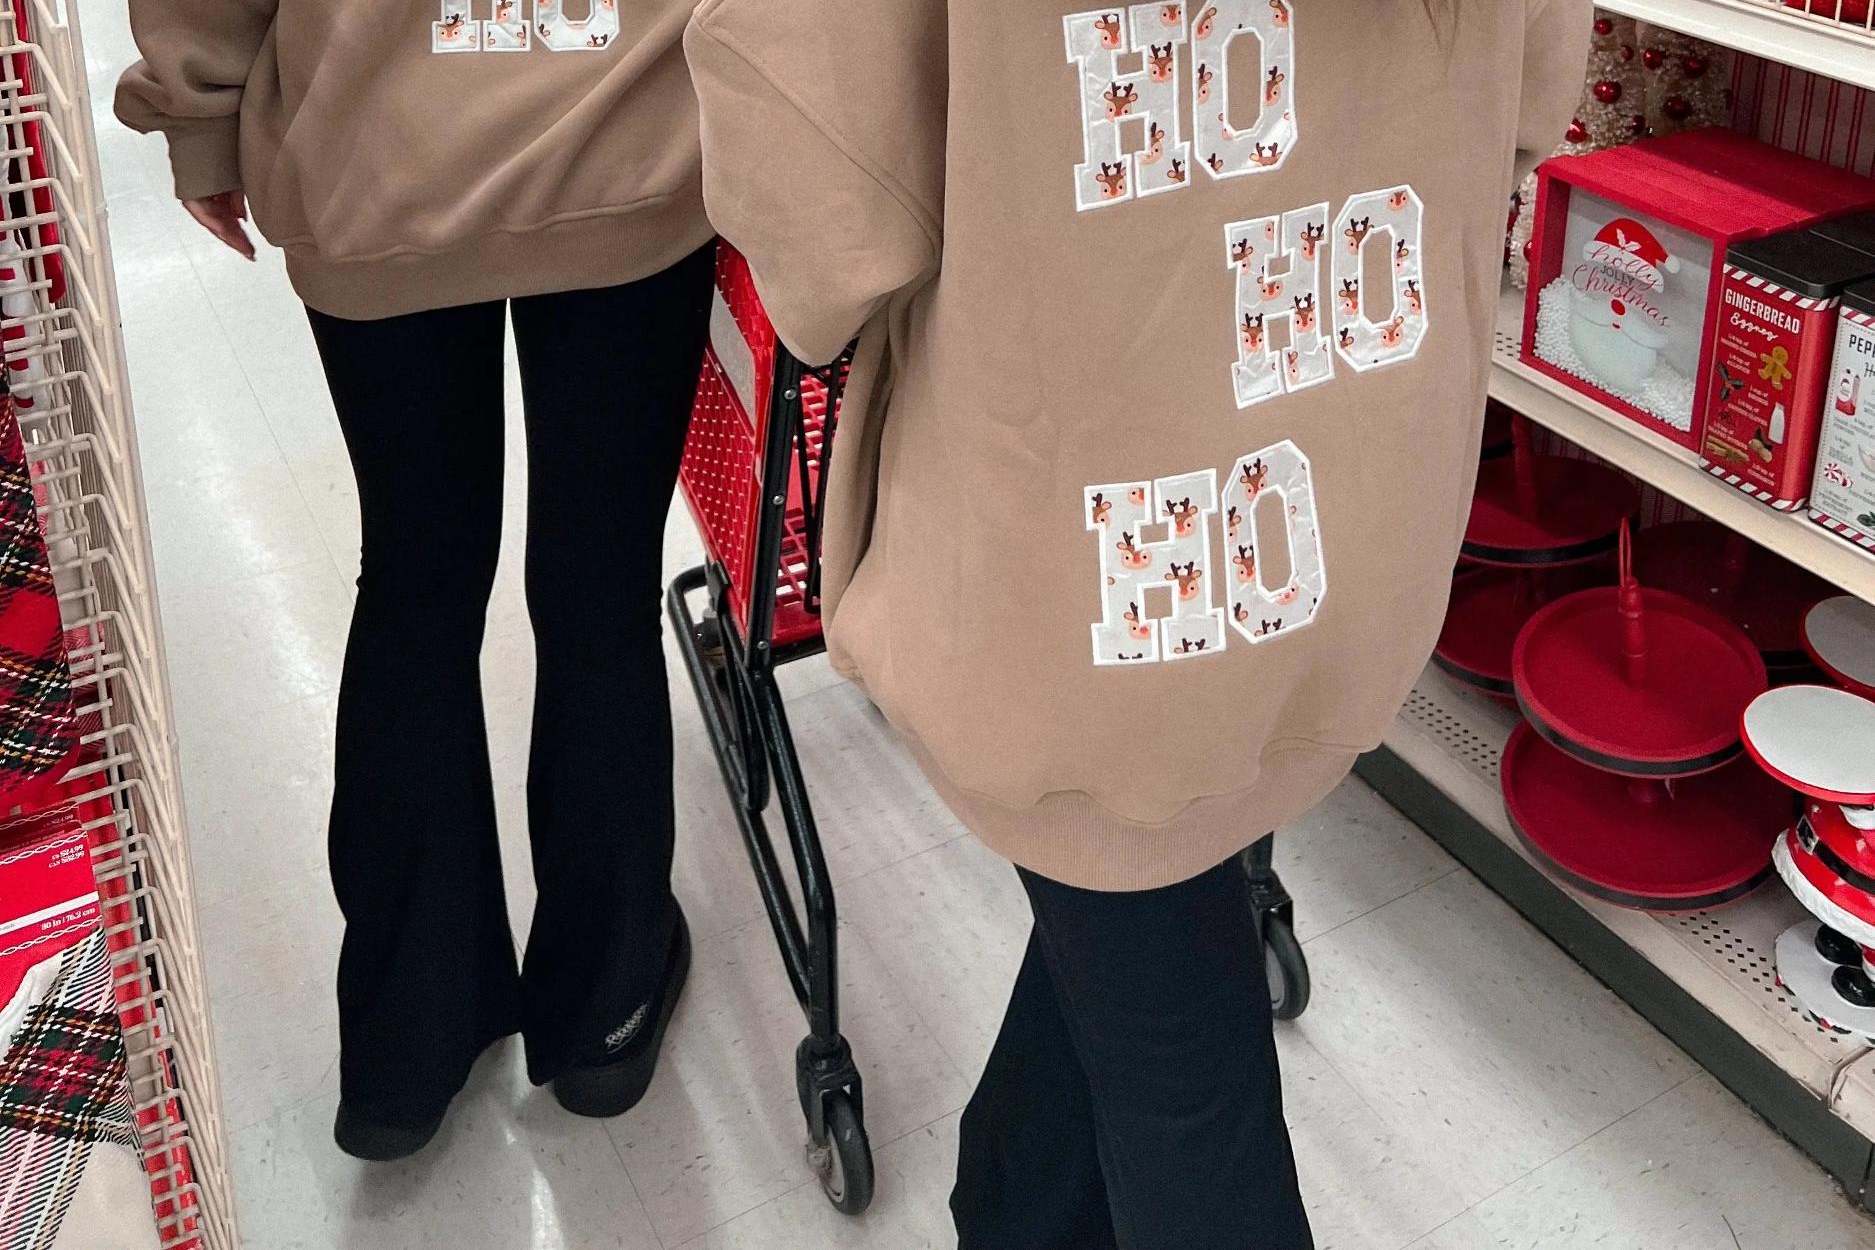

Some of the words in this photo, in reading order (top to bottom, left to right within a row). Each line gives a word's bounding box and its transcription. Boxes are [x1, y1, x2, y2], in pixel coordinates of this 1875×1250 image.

[1572, 264, 1670, 327] Christmas
[1588, 245, 1663, 291] holly
[1600, 264, 1636, 287] JOLLY
[1224, 183, 1429, 410] HO
[1724, 288, 1801, 335] GINGERBREAD
[1083, 438, 1328, 666] HO
